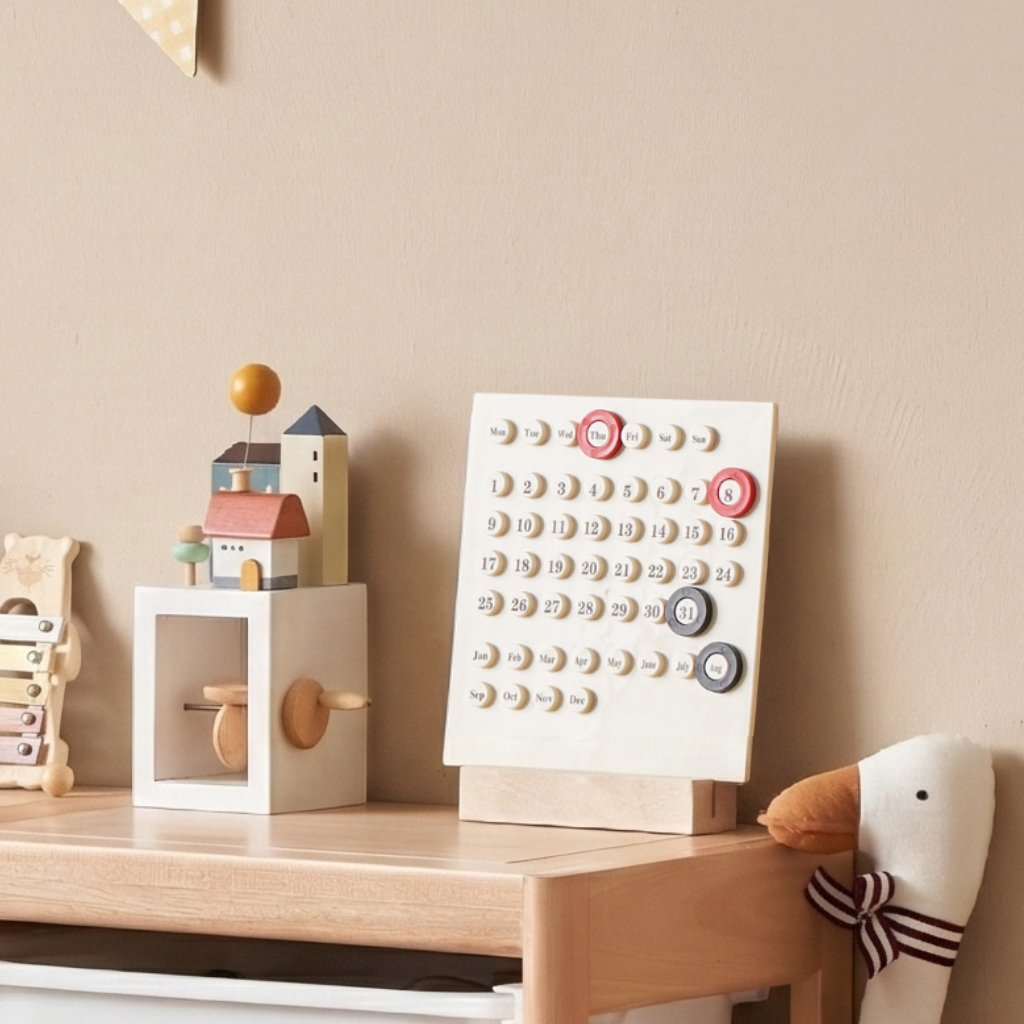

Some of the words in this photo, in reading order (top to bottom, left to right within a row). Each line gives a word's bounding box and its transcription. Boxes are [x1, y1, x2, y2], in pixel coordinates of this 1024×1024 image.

[490, 427, 507, 437] Mon
[524, 428, 540, 438] Tue
[558, 430, 574, 439] Wed
[590, 430, 607, 440] Thu
[626, 432, 639, 441] Fri
[659, 433, 671, 442] Sat
[692, 435, 706, 444] Sun
[491, 480, 497, 493] 1
[523, 480, 532, 494] 2
[557, 482, 566, 495] 3
[589, 484, 597, 497] 4
[623, 485, 632, 498] 5
[656, 486, 665, 499] 6
[691, 487, 700, 500] 7
[724, 488, 733, 502] 8
[487, 517, 496, 531] 9
[517, 518, 532, 532] 10
[551, 520, 565, 534] 11
[584, 521, 599, 535] 12
[618, 523, 633, 536] 13
[651, 524, 666, 537] 14
[685, 526, 699, 539] 15
[719, 527, 735, 541] 16
[481, 557, 496, 570] 17
[514, 558, 529, 572] 18
[548, 560, 563, 573] 19
[581, 561, 598, 575] 20
[614, 563, 629, 577] 21
[648, 564, 664, 578] 22
[682, 566, 697, 580] 23
[716, 567, 732, 581] 24
[478, 597, 493, 610] 25
[511, 598, 527, 611] 26
[544, 599, 560, 613] 27
[578, 601, 594, 615] 28
[611, 603, 627, 616] 29
[644, 604, 660, 618] 30
[679, 606, 694, 620] 31
[473, 651, 488, 661] Jan
[508, 652, 522, 662] Feb
[539, 654, 555, 664] Mar
[575, 655, 588, 667] Apr
[607, 657, 622, 669] May
[641, 659, 657, 669] June
[676, 661, 690, 673] July
[710, 663, 722, 674] Aug
[469, 689, 485, 701] Sep
[503, 690, 518, 701] Oct
[536, 693, 553, 703] Nov
[569, 695, 585, 705] Dec
